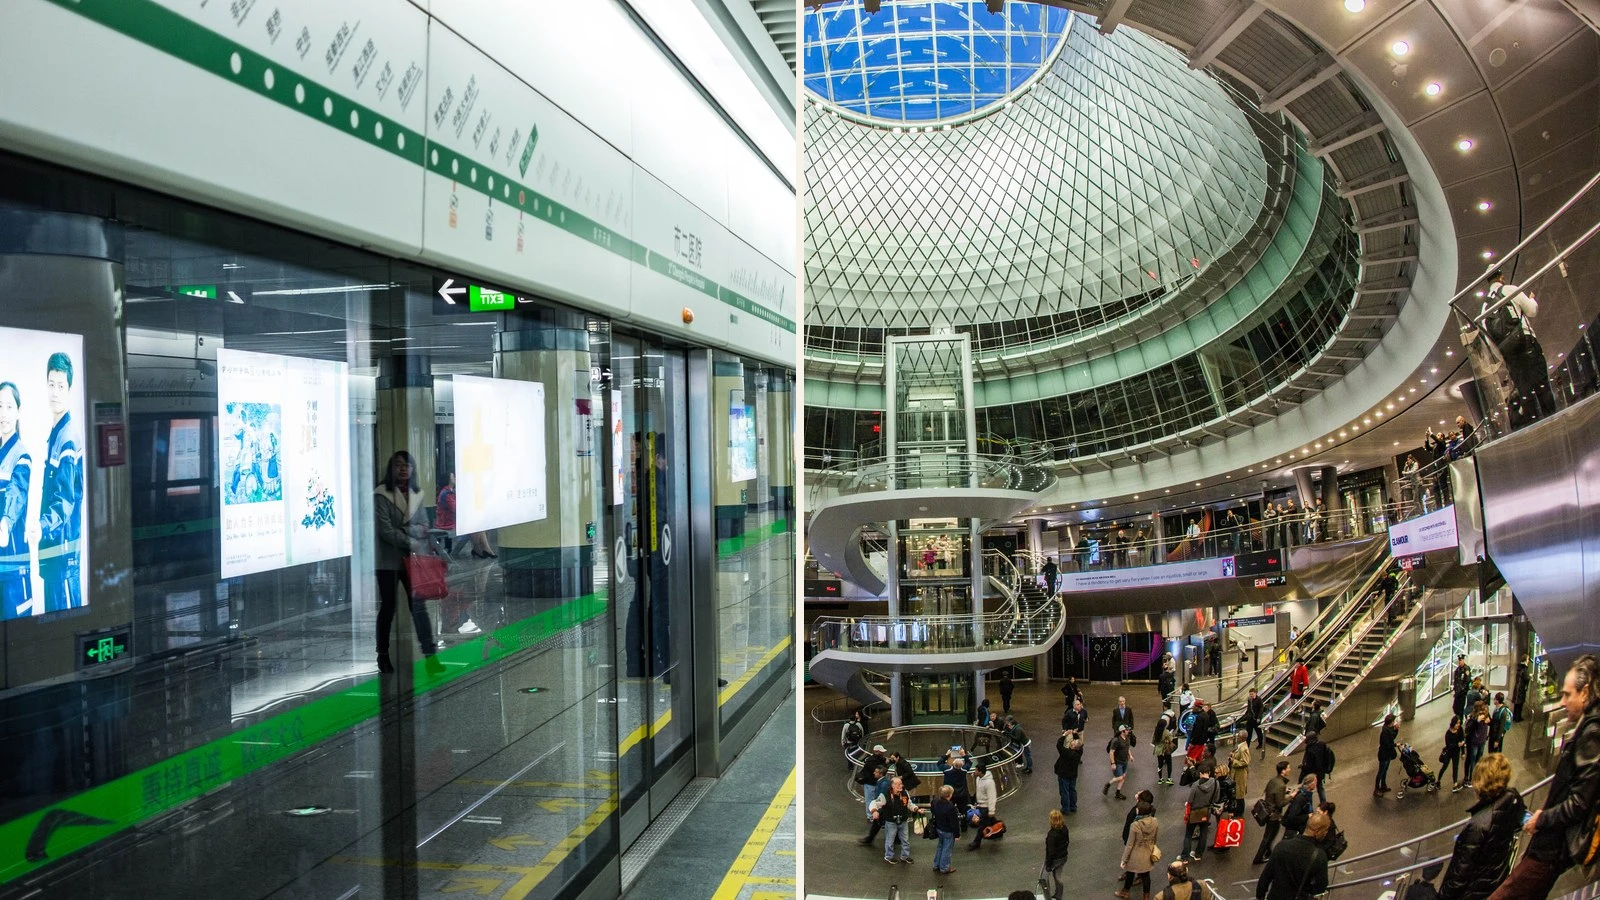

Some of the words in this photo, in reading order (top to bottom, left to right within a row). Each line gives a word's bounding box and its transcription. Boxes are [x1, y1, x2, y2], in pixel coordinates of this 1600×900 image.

[674, 224, 703, 269] 市二医院
[1392, 535, 1409, 546] GLAMOUR
[1254, 578, 1266, 587] Exit
